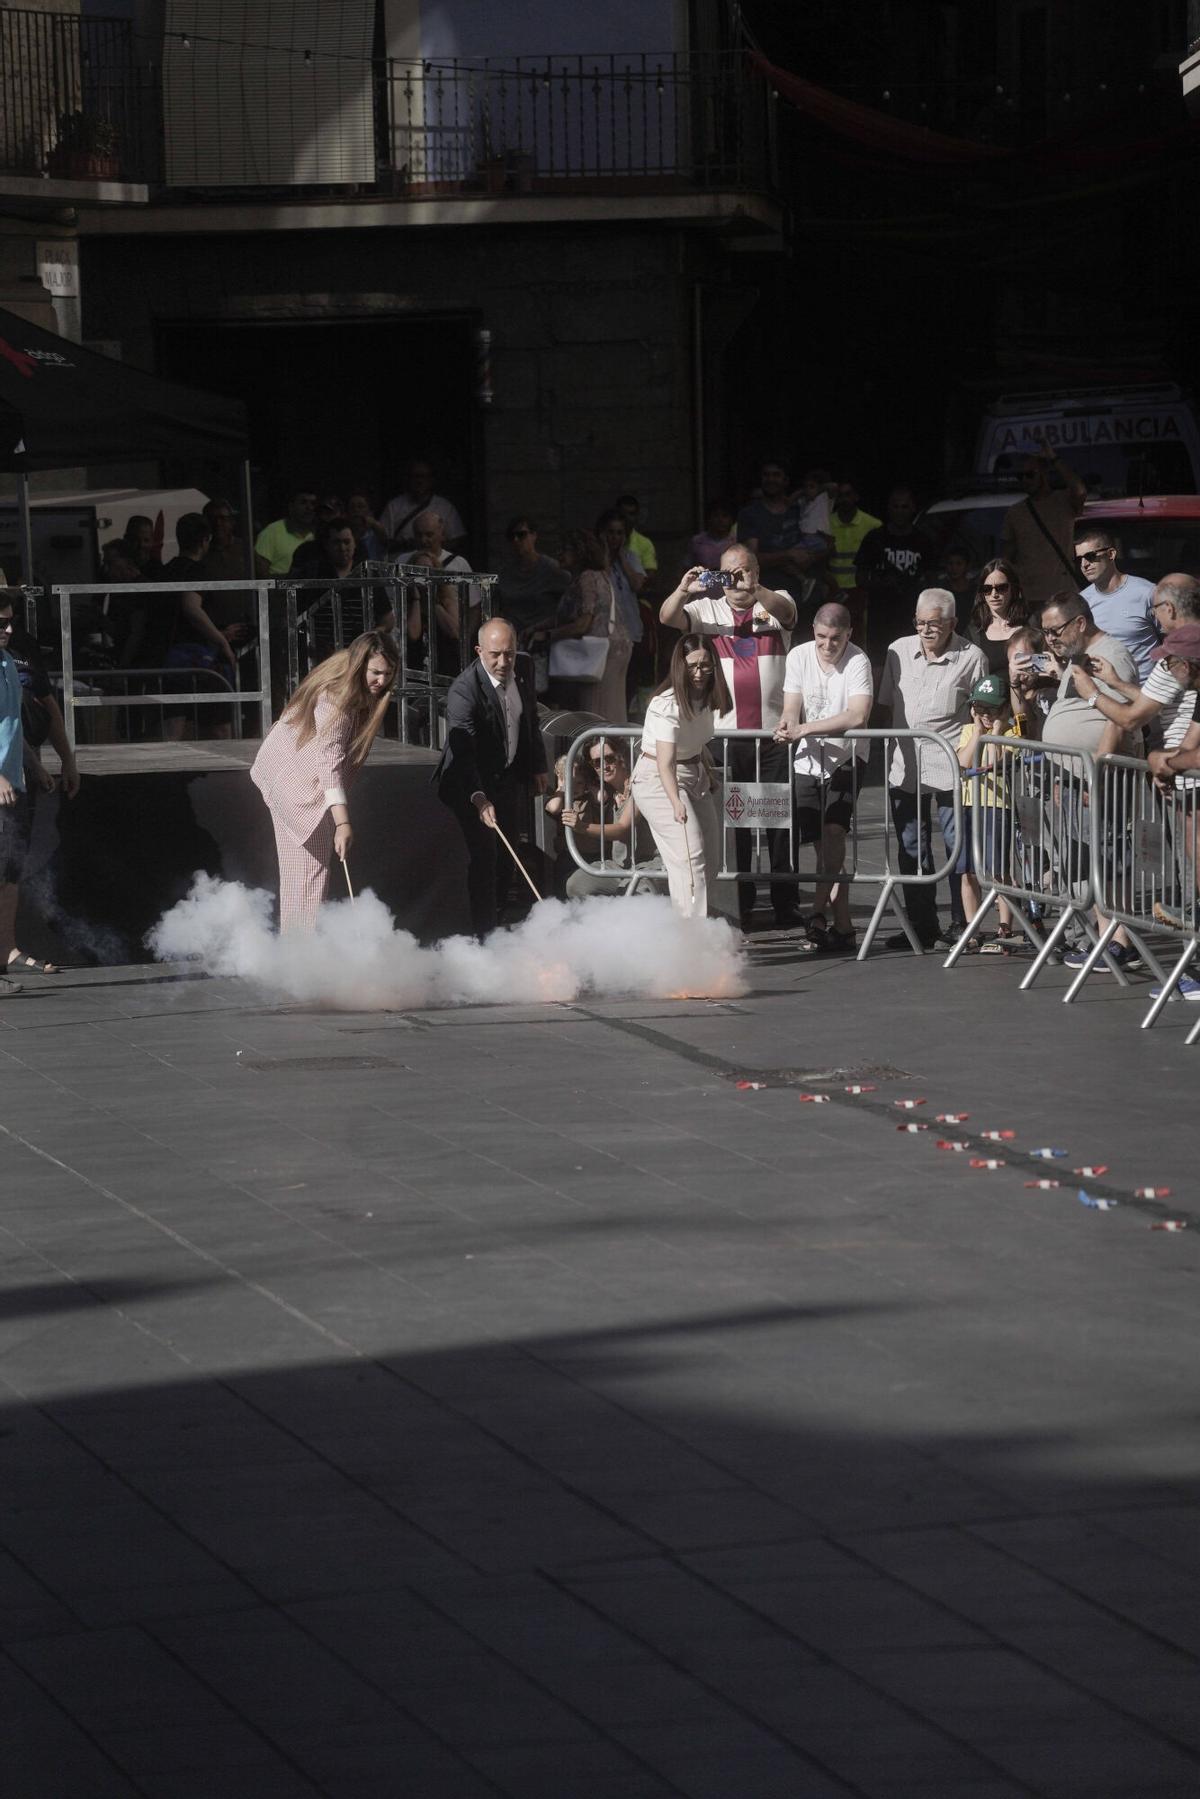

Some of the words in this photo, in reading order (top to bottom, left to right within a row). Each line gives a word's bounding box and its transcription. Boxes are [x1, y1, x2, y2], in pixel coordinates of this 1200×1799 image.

[1002, 415, 1181, 449] AMBULANCIA
[747, 796, 790, 807] Ajuntament
[747, 808, 756, 818] de
[758, 808, 789, 818] Manresa
